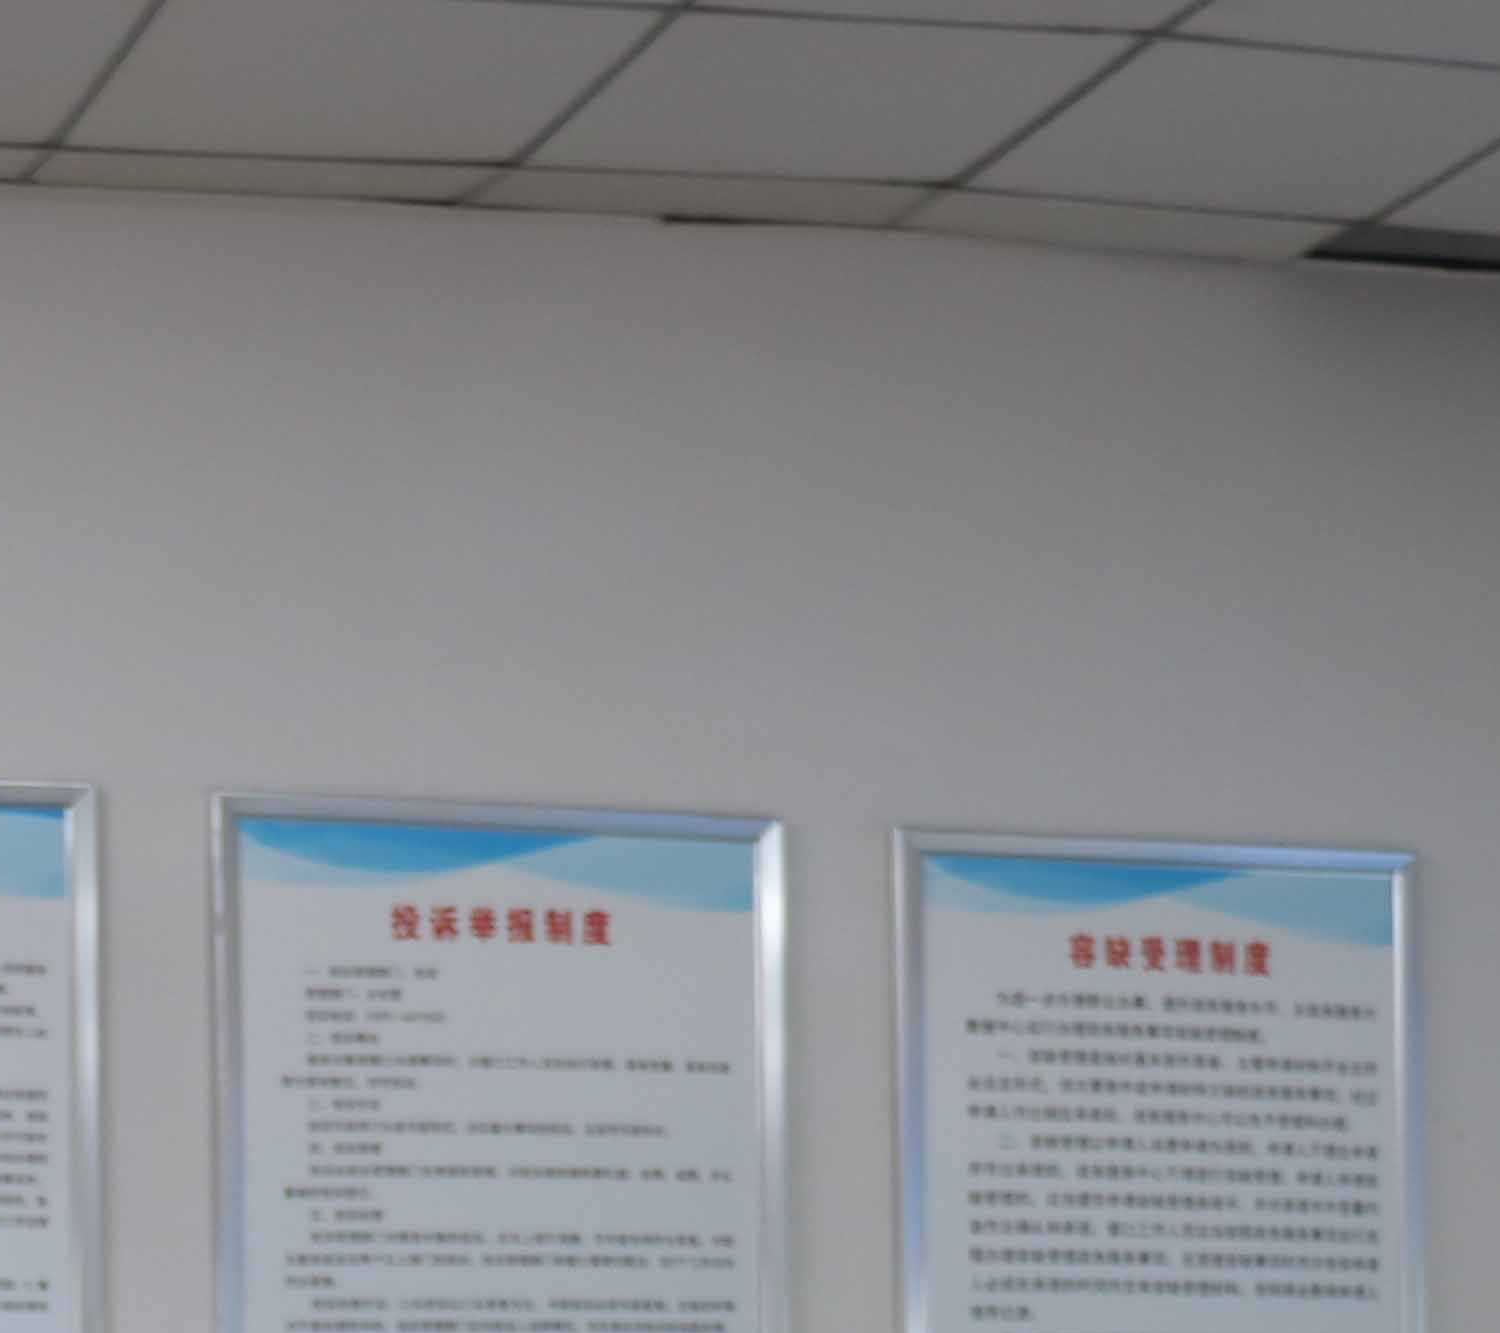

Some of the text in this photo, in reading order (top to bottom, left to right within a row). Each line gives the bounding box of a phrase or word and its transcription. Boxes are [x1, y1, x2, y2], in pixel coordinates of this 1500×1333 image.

[391, 903, 612, 945] 投诉举报制度
